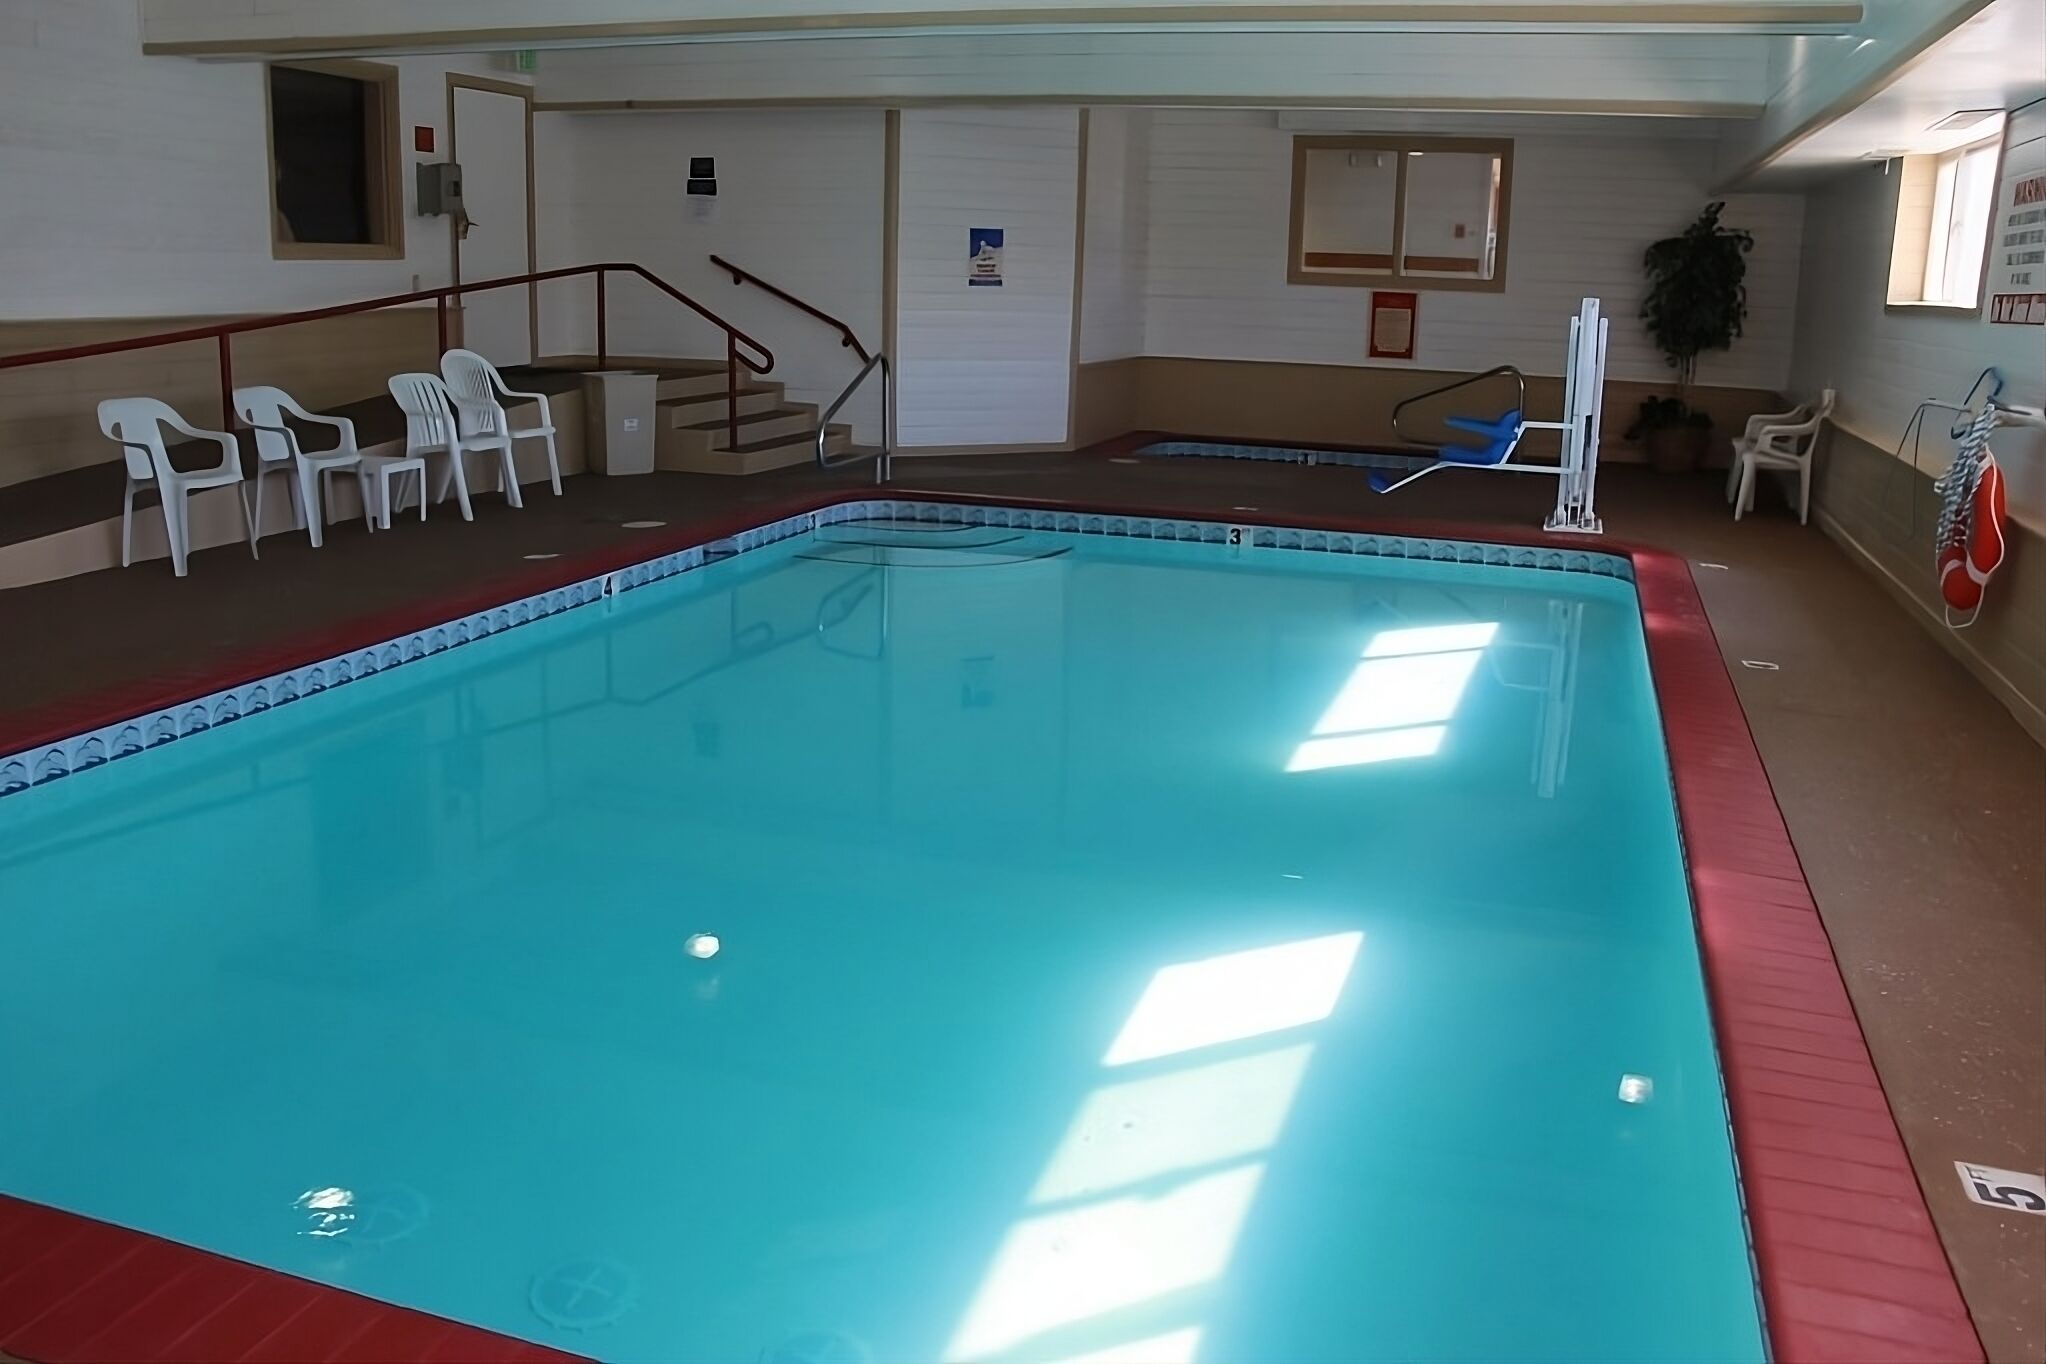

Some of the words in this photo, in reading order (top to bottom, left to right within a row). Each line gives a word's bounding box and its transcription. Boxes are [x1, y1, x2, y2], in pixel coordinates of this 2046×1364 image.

[1230, 528, 1241, 544] 3
[603, 576, 612, 595] 4
[1973, 1181, 2046, 1211] 5
